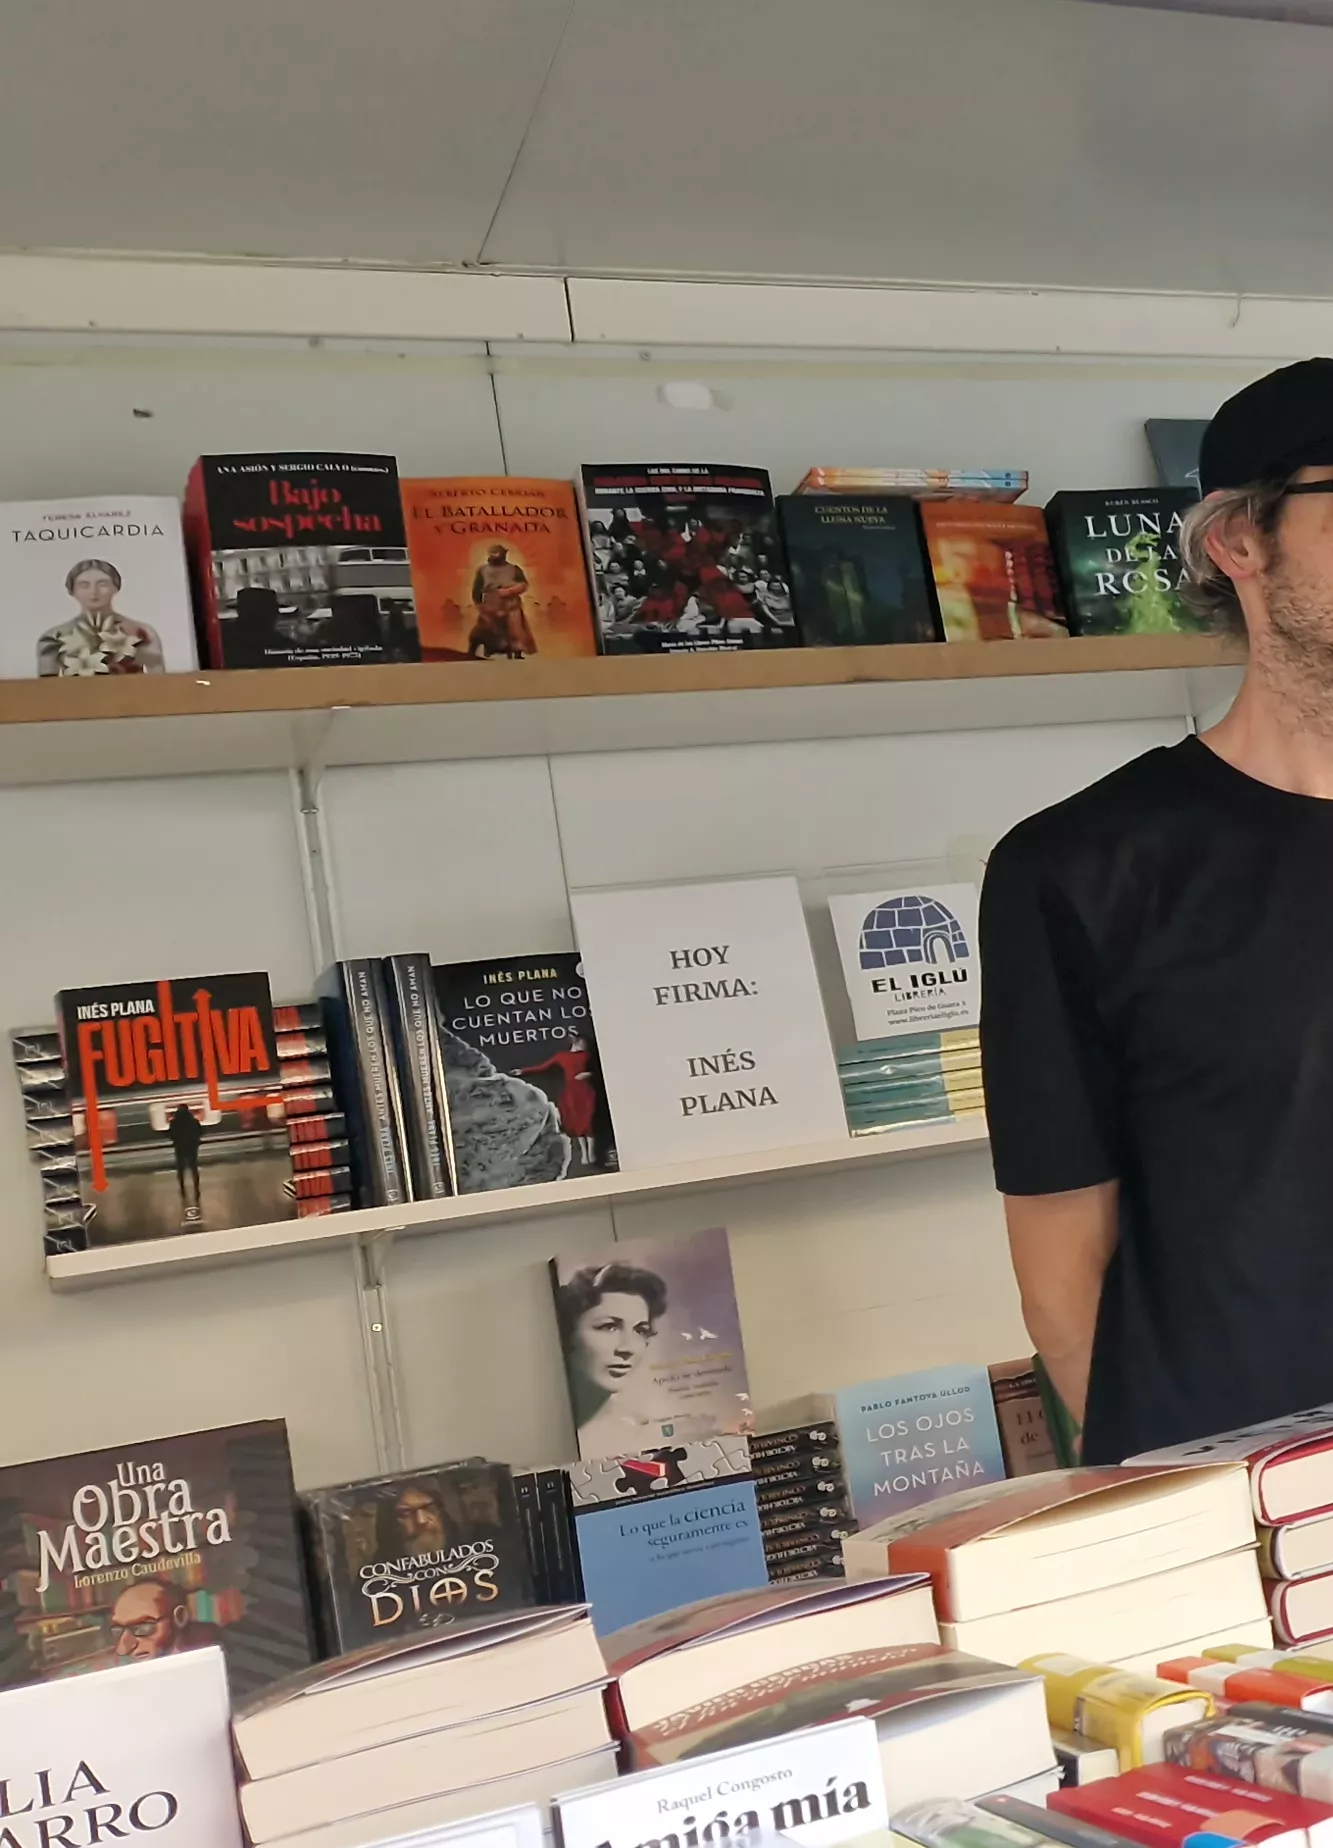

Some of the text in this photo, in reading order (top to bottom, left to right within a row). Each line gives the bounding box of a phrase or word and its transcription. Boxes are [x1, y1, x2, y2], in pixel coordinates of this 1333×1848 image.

[269, 478, 342, 511] Bajo
[233, 505, 382, 539] sospecha
[412, 504, 569, 520] EL BATALLADOR
[1084, 511, 1185, 539] LUNA
[12, 523, 165, 544] TAQUICARDIA
[450, 519, 552, 535] GRANADA
[1093, 567, 1192, 596] ROSA
[669, 944, 730, 970] HOY
[358, 971, 369, 999] AMAN
[407, 965, 419, 992] AMAN
[483, 968, 558, 985] INÉS PLANA
[871, 966, 968, 993] EL IGLÚ
[410, 992, 420, 1007] NO
[464, 986, 582, 1010] LO QUE NO
[652, 977, 759, 1006] FIRMA:
[894, 987, 947, 1002] LIBRERÍA
[77, 999, 155, 1020] INÉS PLANA
[362, 999, 371, 1014] NO
[413, 1007, 424, 1028] QUE
[452, 1005, 592, 1030] CUENTAN LO
[77, 983, 272, 1090] FUGITIVA
[363, 1013, 375, 1035] QUE
[479, 1025, 579, 1047] MUERTOS
[687, 1048, 757, 1078] INÉS
[679, 1084, 779, 1117] PLANA
[860, 1400, 893, 1413] PABLO
[894, 1392, 938, 1406] FANTOVA
[866, 1407, 976, 1443] LOS OJOS
[1020, 1432, 1039, 1445] de
[880, 1436, 970, 1467] TRAS LA
[116, 1461, 166, 1487] Una
[874, 1459, 985, 1497] MONTAÑA
[72, 1478, 196, 1533] Obra
[619, 1498, 747, 1537] Lo que la ciencia
[647, 1522, 731, 1549] seguramente
[35, 1507, 233, 1592] Maestra
[359, 1538, 495, 1580] CONFABULADOS
[73, 1552, 201, 1589] Lorenzo Caudevilla
[414, 1564, 451, 1582] CON
[370, 1569, 499, 1627] DIOS
[0, 1760, 111, 1818] LIA
[656, 1767, 794, 1815] Raquel Congosto
[770, 1775, 872, 1832] mía
